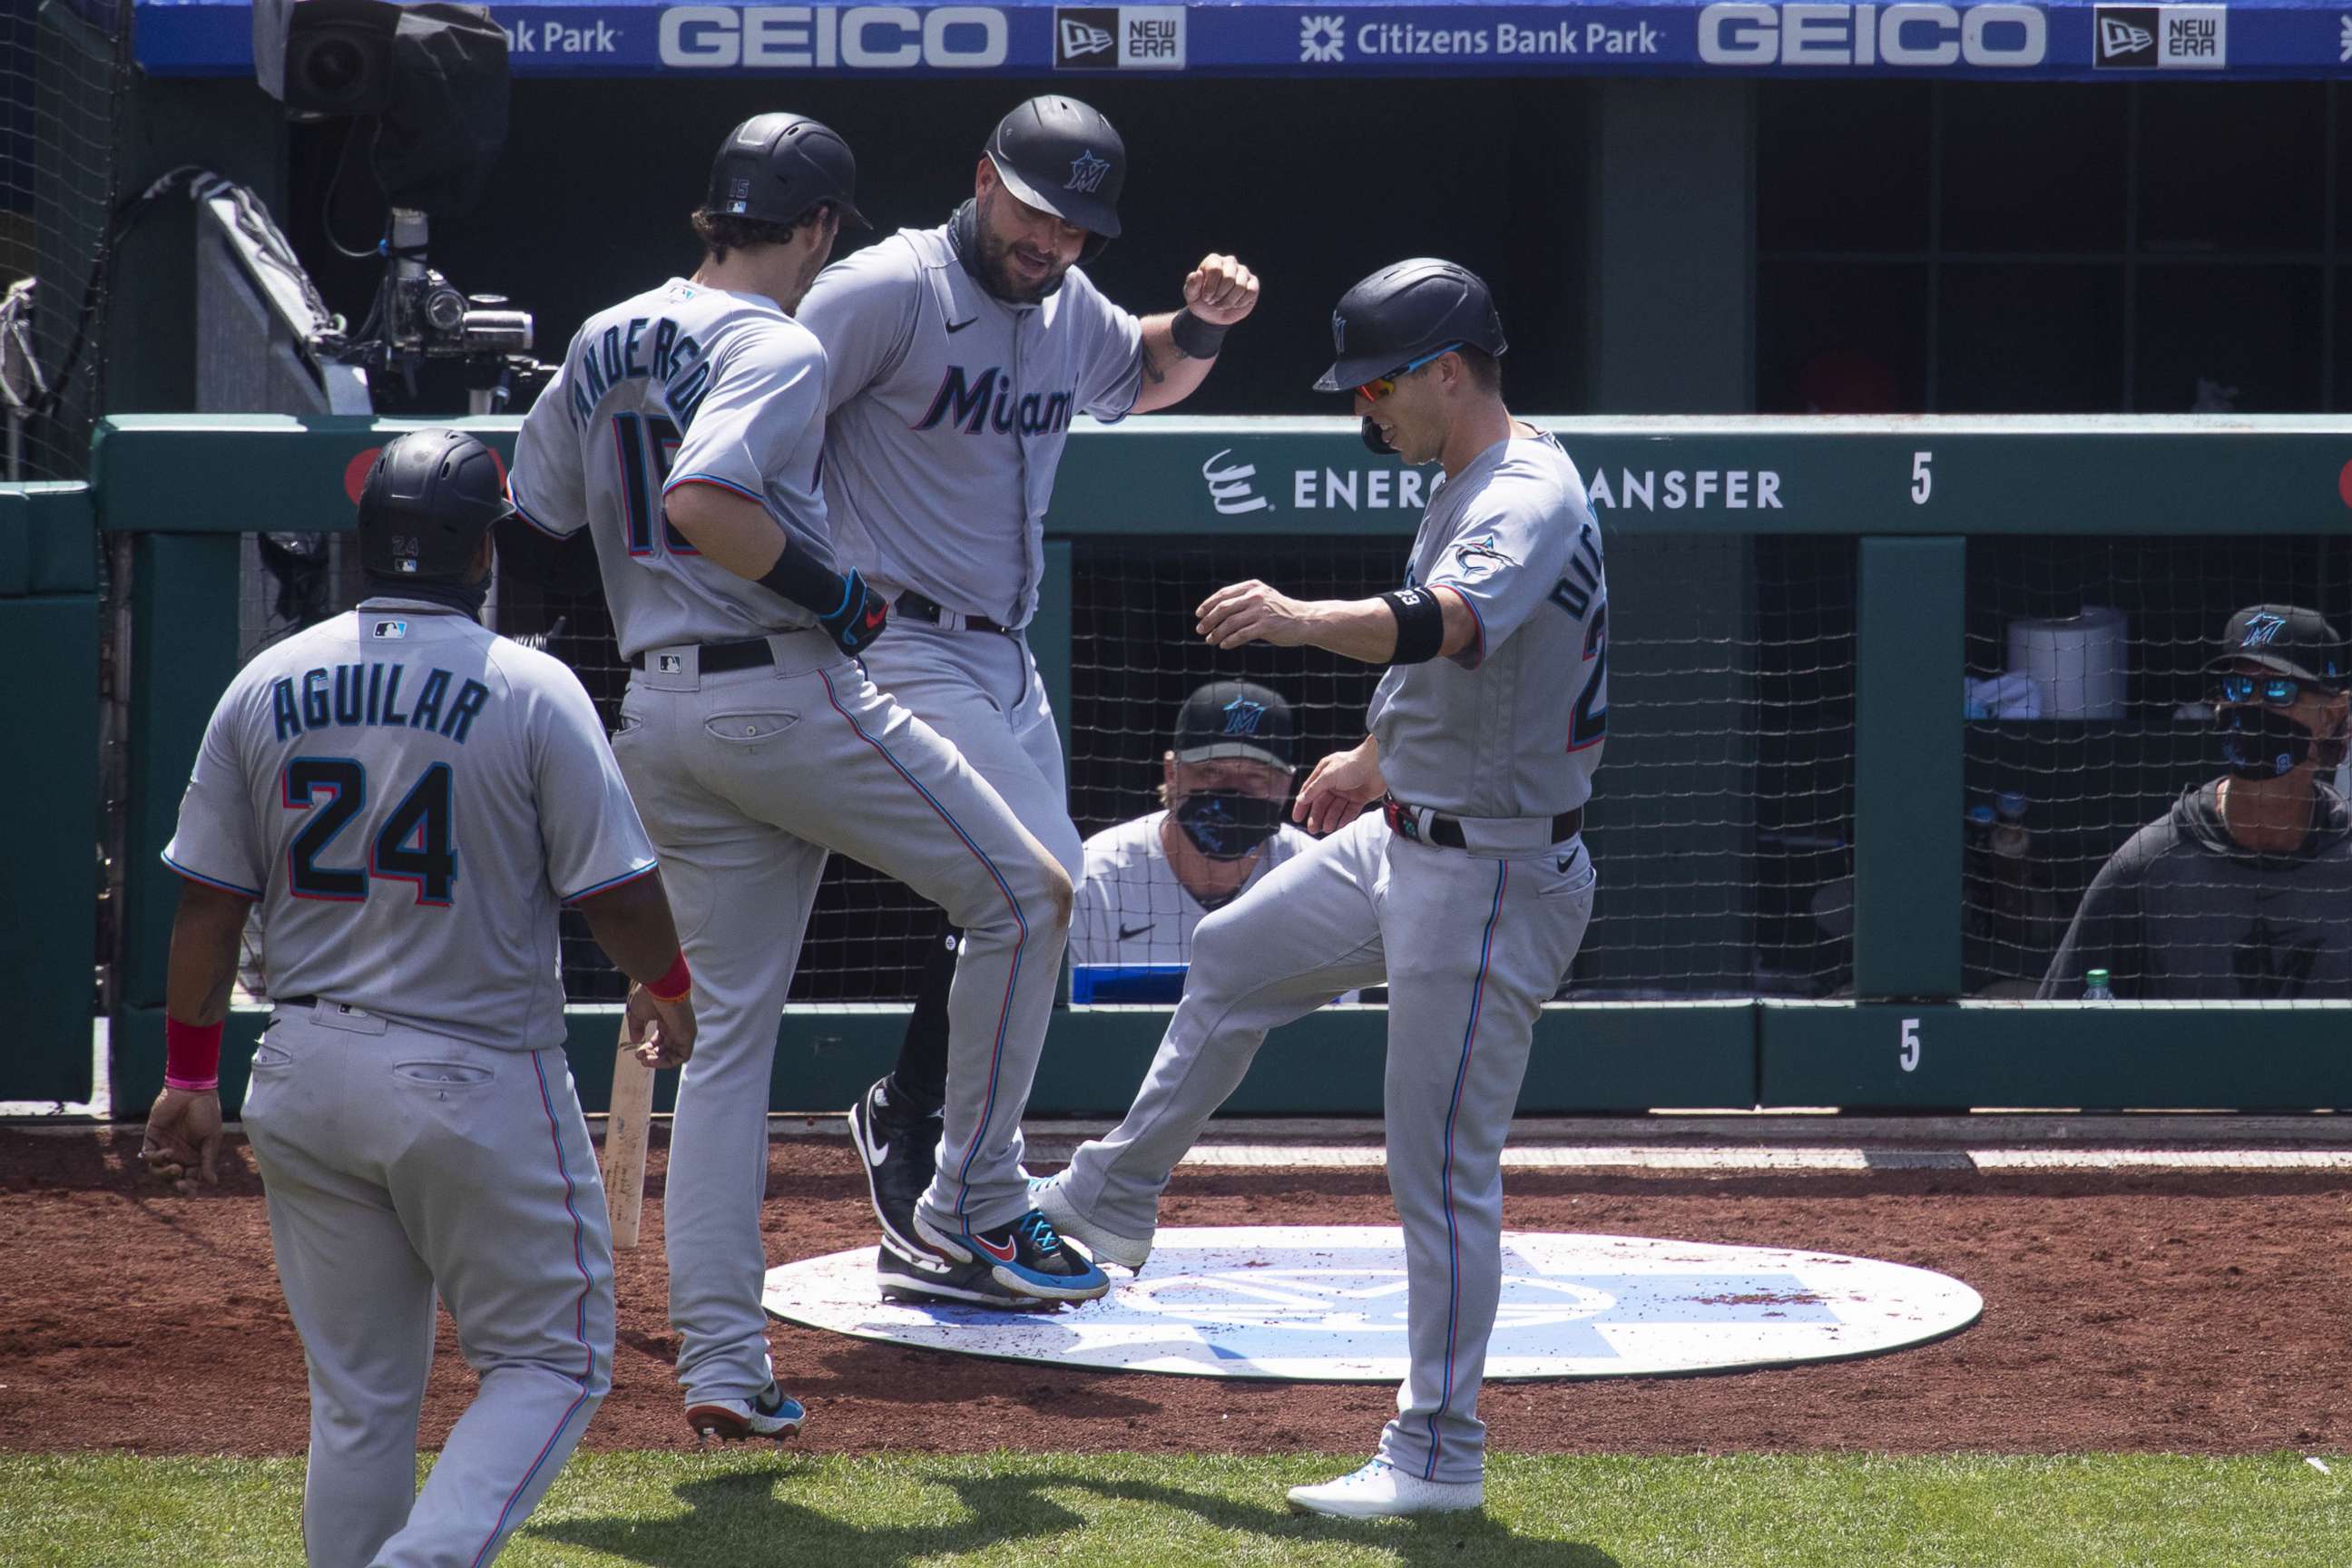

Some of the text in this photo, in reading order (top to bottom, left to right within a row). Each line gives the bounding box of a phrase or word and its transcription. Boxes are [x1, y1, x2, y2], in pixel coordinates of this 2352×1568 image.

[544, 20, 615, 52] Park
[660, 6, 1008, 68] GEICO
[1129, 21, 1176, 38] NEW
[1129, 40, 1176, 57] ERA
[1357, 22, 1657, 54] Citizens Bank Park
[1699, 4, 2046, 66] GEICO
[2169, 19, 2215, 37] NEW
[2169, 39, 2215, 56] ERA
[910, 365, 1079, 436] Miam
[1911, 452, 1932, 505] 5
[275, 662, 491, 744] AGUILAR
[282, 756, 458, 907] 24
[1900, 1018, 1920, 1072] 5
